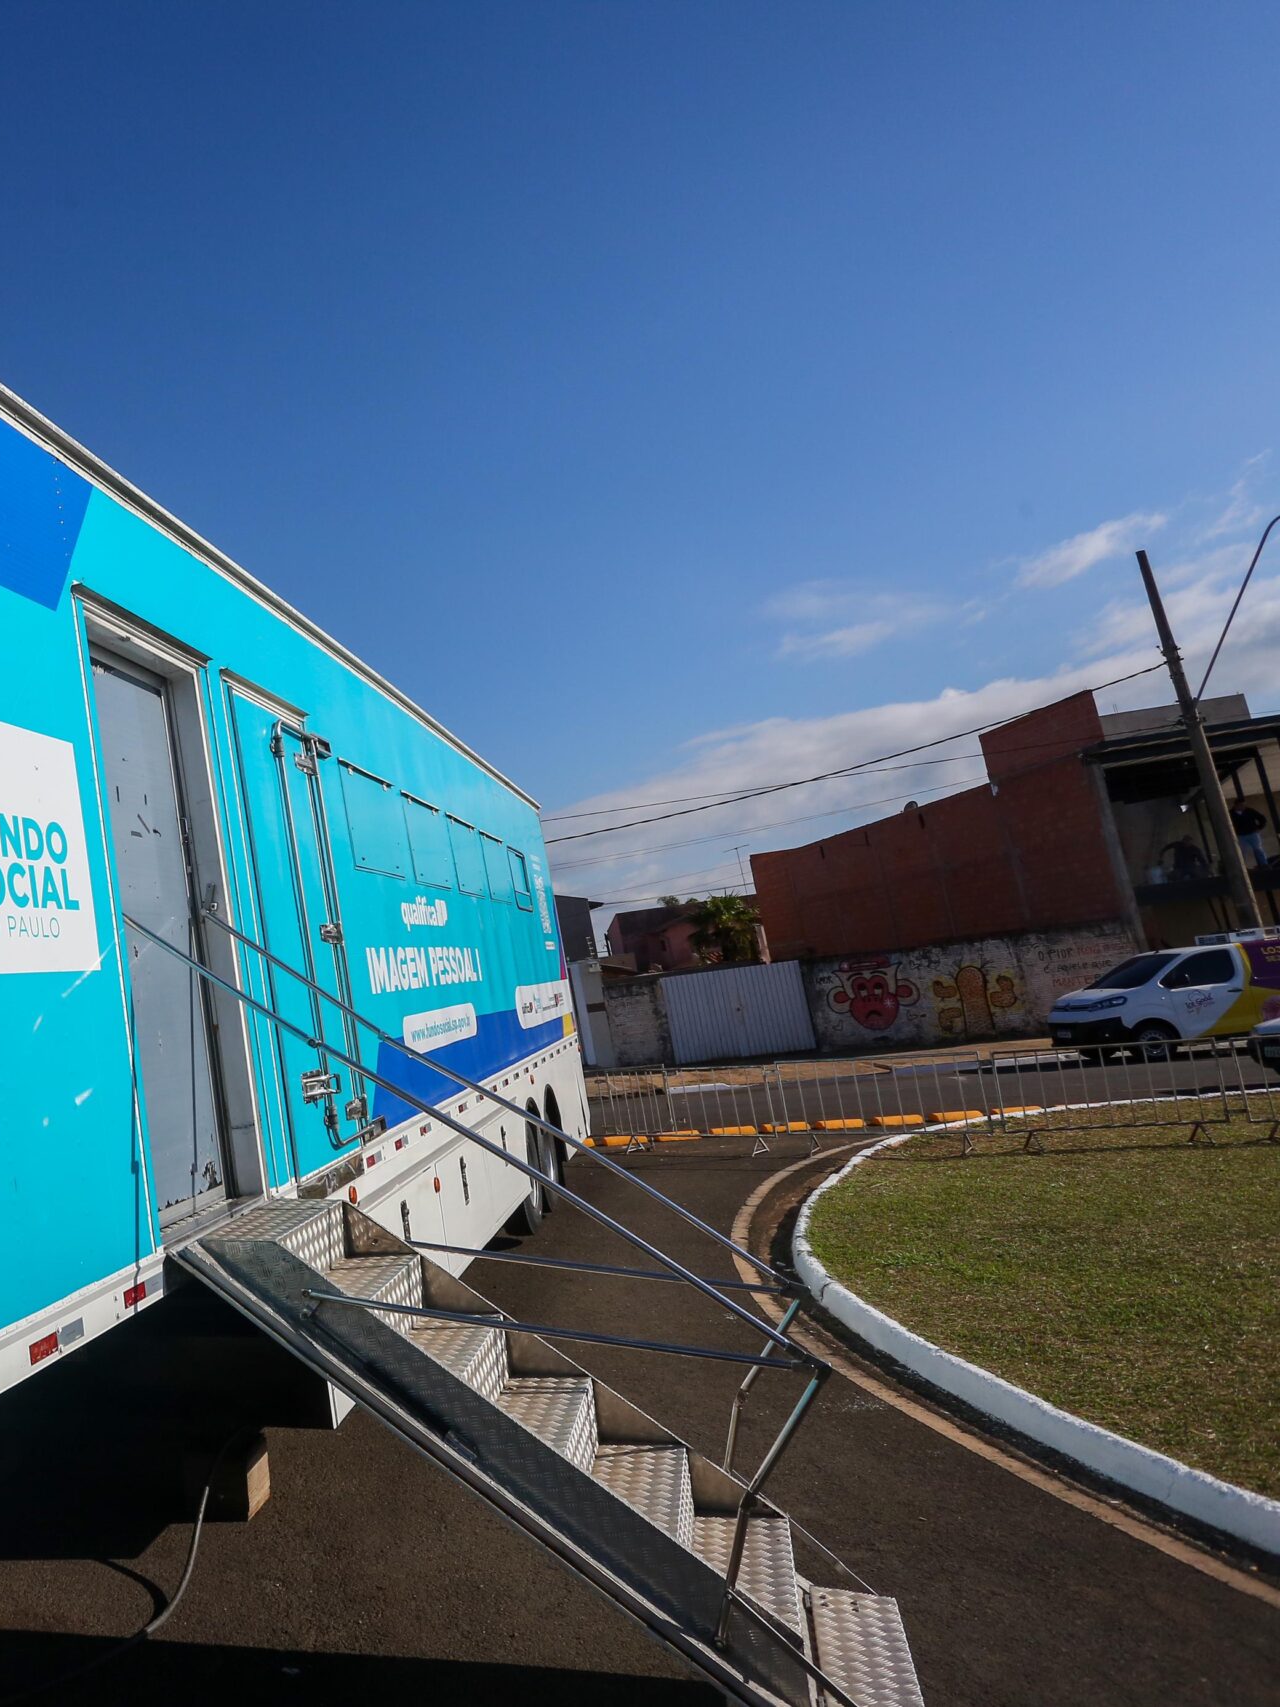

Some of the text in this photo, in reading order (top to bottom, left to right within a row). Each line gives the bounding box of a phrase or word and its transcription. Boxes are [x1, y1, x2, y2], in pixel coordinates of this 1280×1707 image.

[7, 915, 61, 939] PAULO
[365, 946, 430, 995] IMAGEM
[429, 946, 477, 986] PESSOAL
